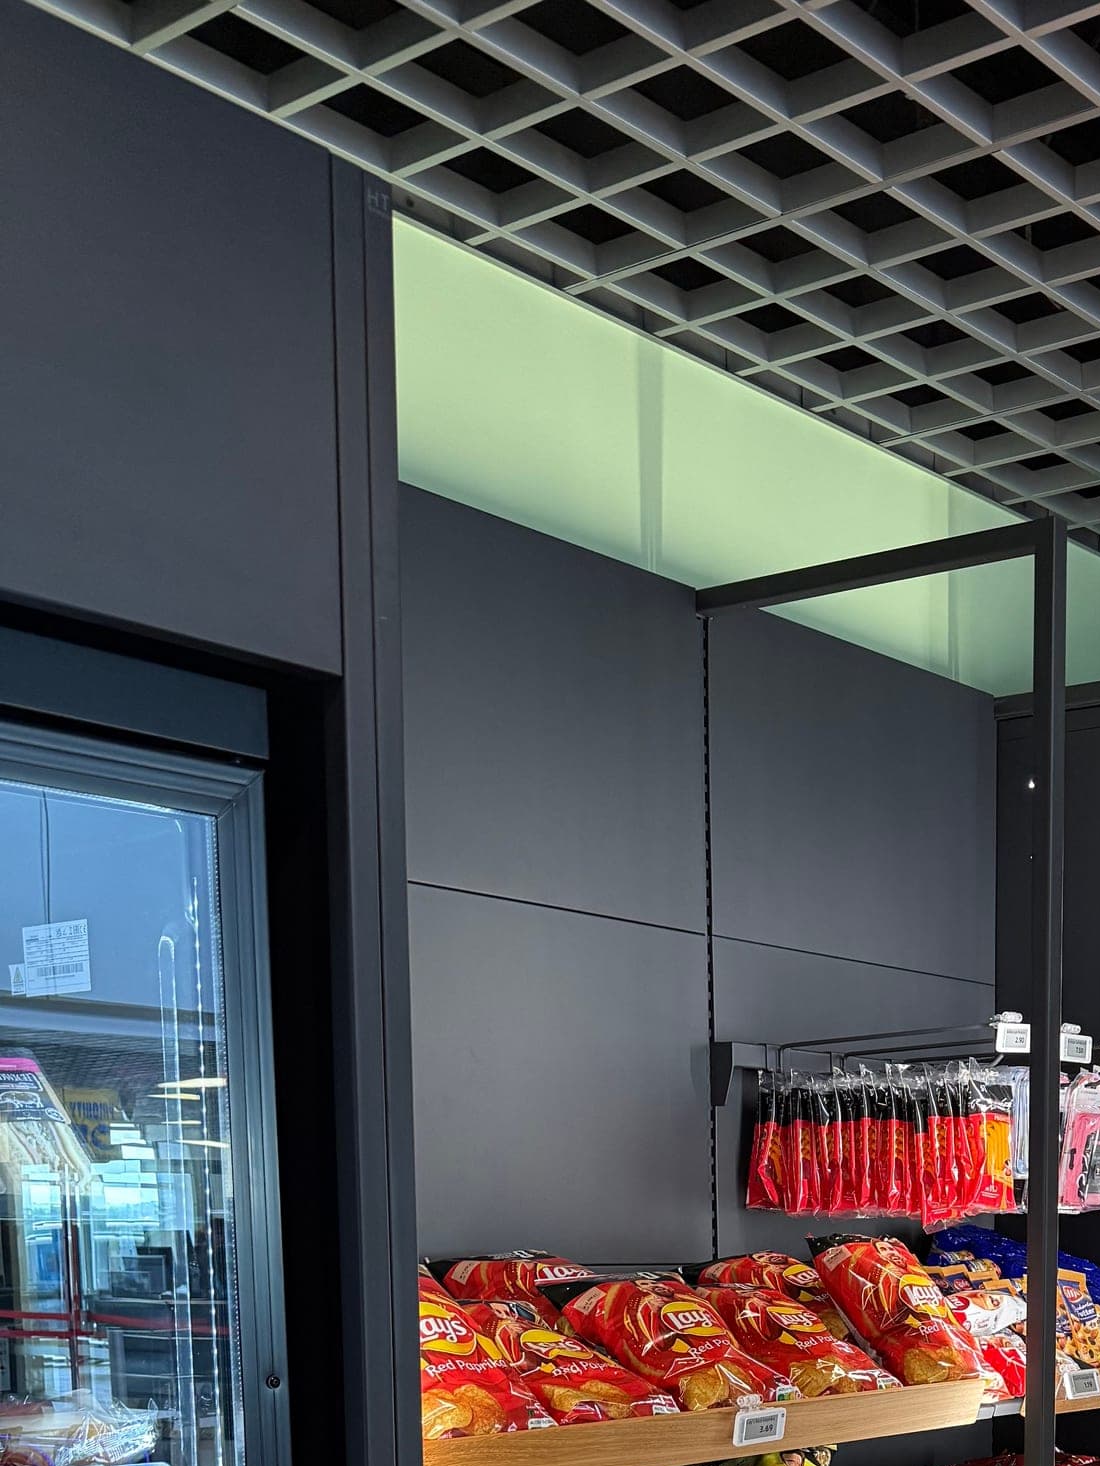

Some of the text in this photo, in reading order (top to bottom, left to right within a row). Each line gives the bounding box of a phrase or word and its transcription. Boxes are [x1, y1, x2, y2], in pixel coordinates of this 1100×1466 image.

[919, 1322, 940, 1336] Red
[688, 1340, 714, 1359] Red
[795, 1337, 817, 1350] Red
[425, 1359, 507, 1377] Red Paprika
